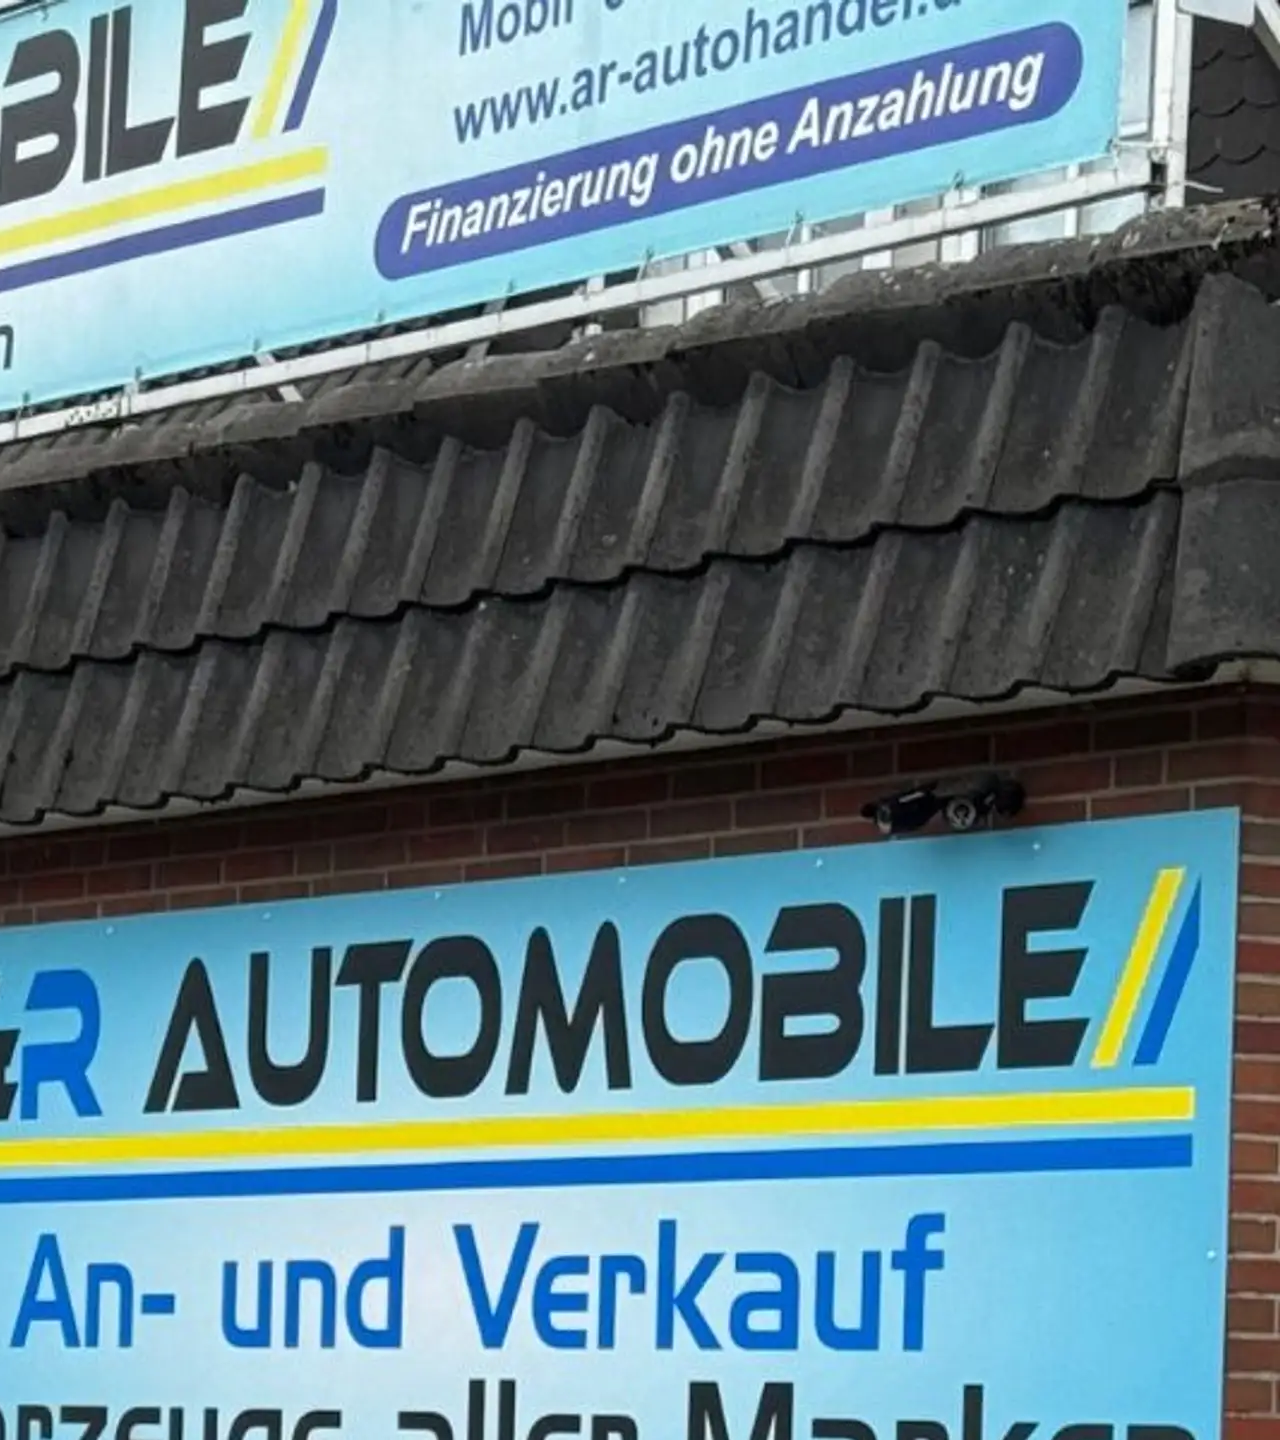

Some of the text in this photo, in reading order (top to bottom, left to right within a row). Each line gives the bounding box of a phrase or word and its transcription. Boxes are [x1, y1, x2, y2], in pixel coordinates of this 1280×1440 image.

[401, 49, 1044, 253] Finanzierung ohne Anzahlung
[454, 0, 961, 143] www.ar-autohande.
[142, 880, 1096, 1114] AUTOMOBILE
[10, 1212, 945, 1351] An- und Verkauf
